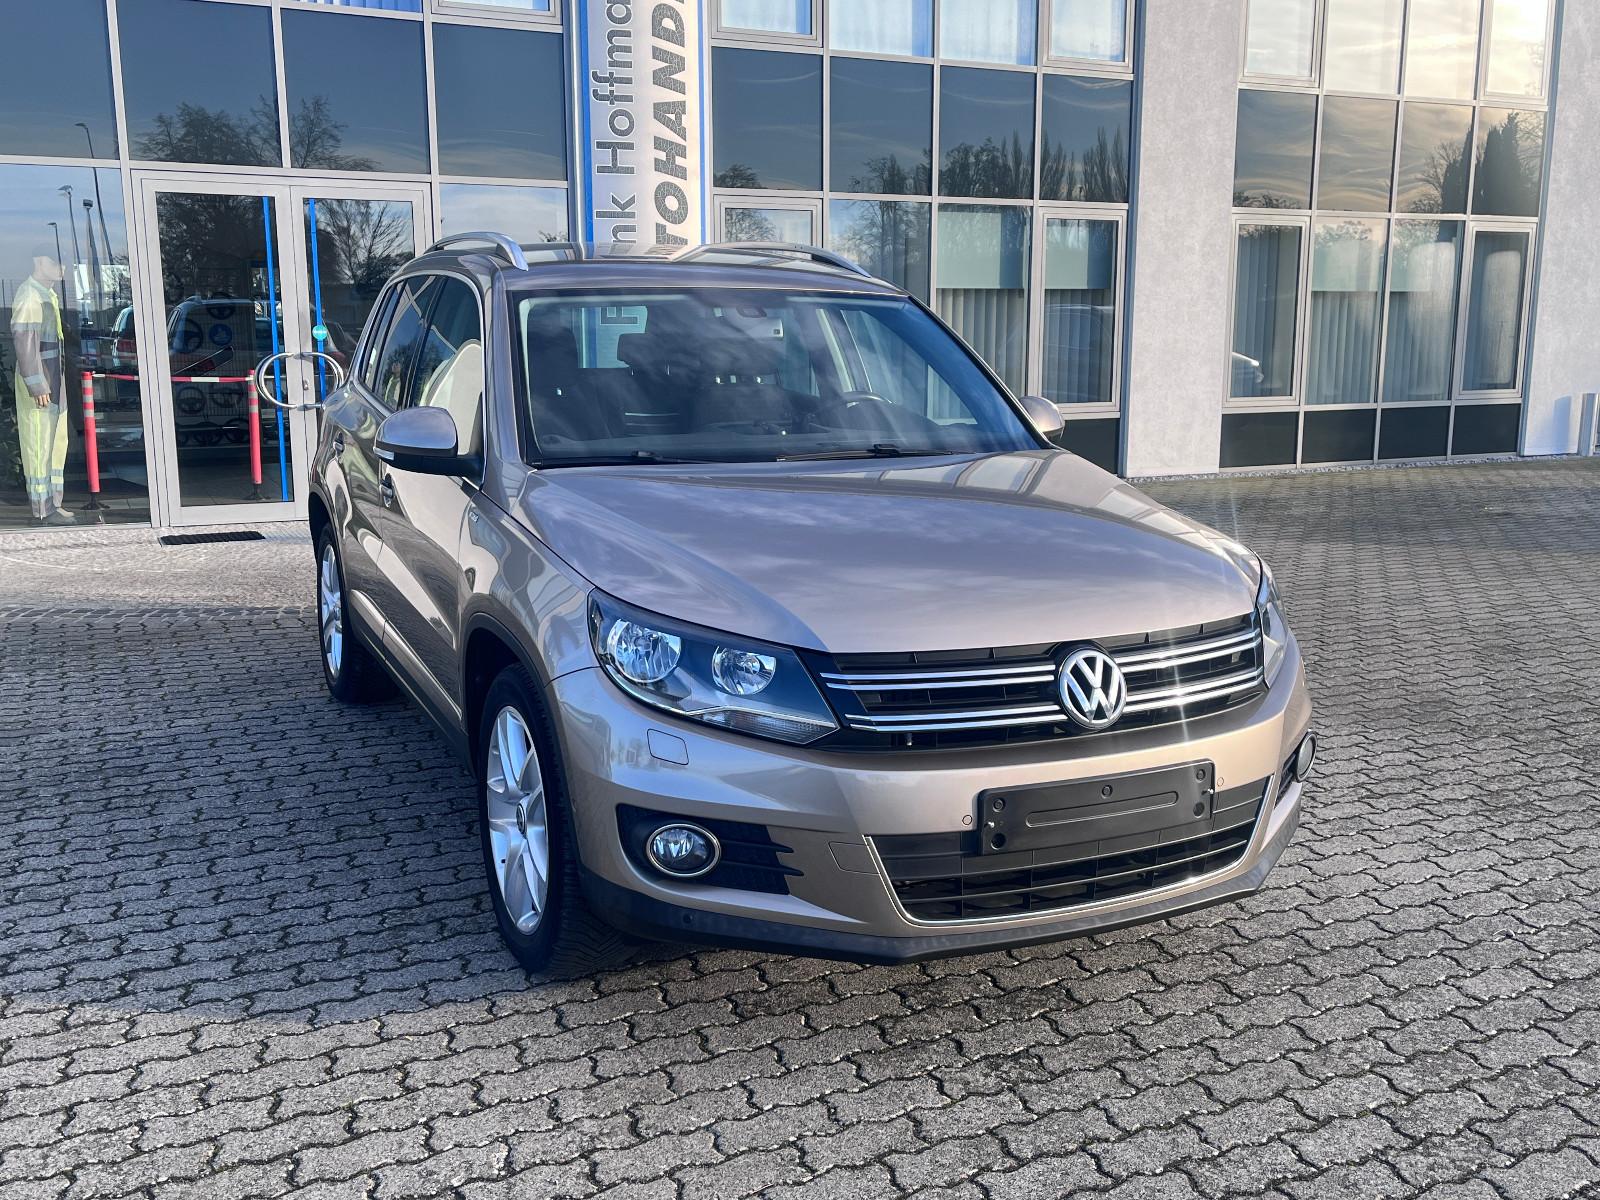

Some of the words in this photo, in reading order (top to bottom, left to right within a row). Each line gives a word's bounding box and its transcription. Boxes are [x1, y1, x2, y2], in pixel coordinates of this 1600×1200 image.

[592, 0, 636, 175] Hoffma
[651, 0, 689, 246] TOHAND
[595, 194, 637, 244] nk
[1059, 649, 1126, 728] VW
